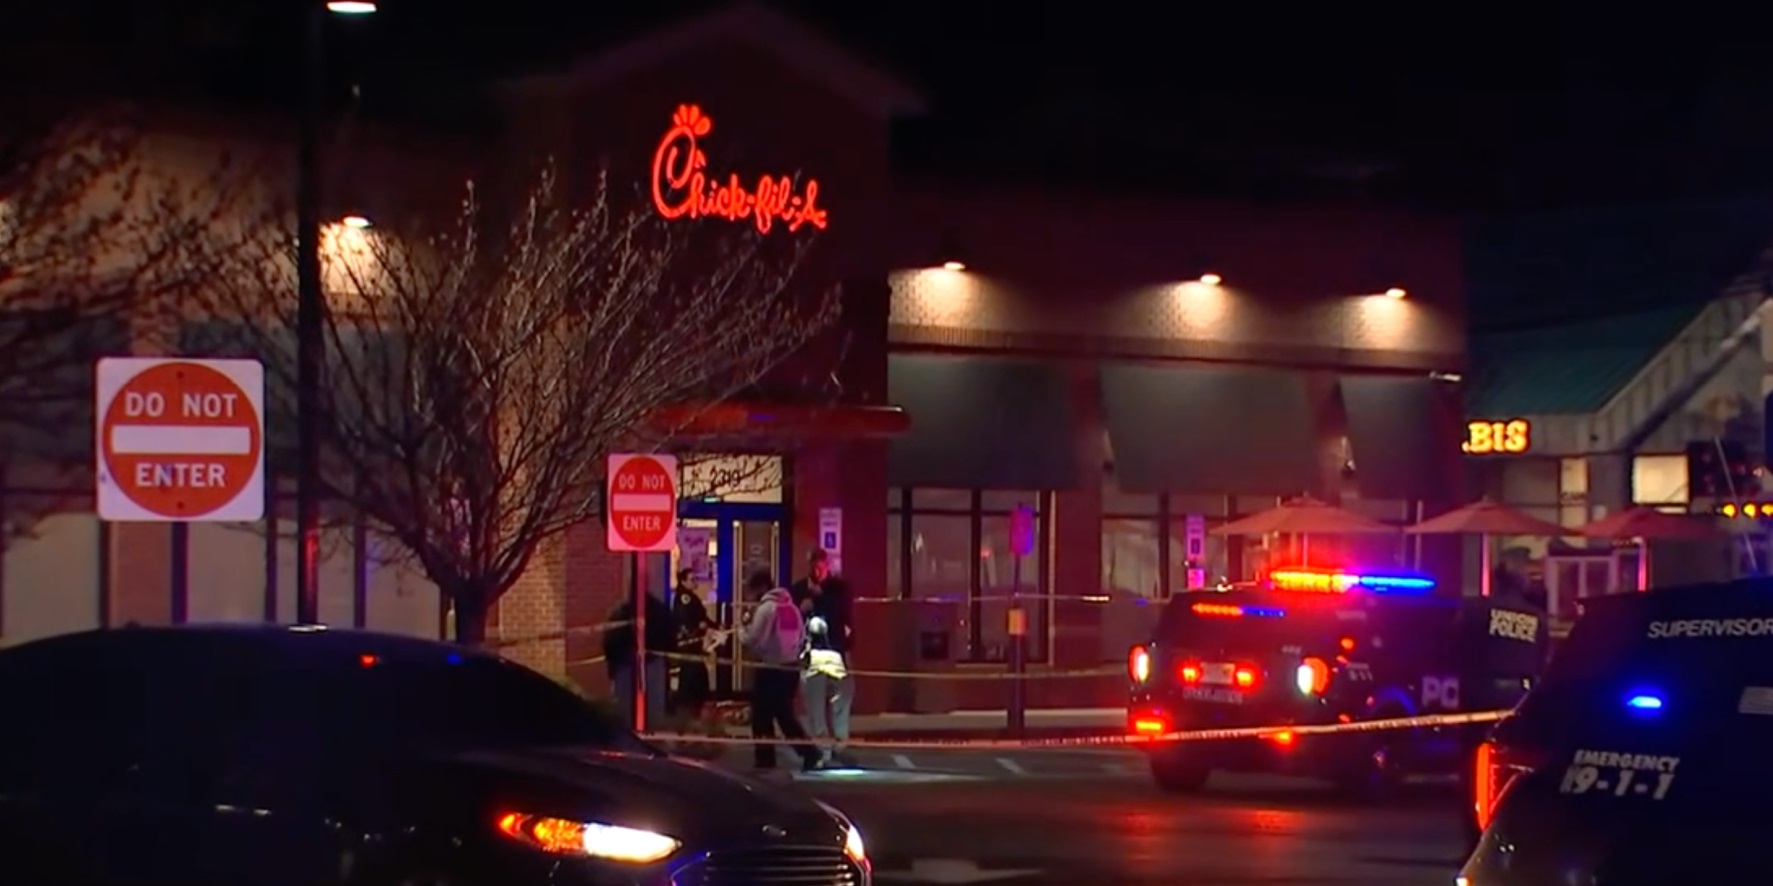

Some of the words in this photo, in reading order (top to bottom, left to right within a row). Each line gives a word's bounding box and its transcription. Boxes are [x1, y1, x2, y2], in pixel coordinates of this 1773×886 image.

[653, 104, 827, 233] Chick-fil-A
[125, 392, 165, 417] DO
[182, 393, 237, 418] NOT
[1462, 420, 1528, 452] BIS
[135, 463, 226, 488] ENTER
[618, 474, 636, 490] DO
[642, 474, 666, 490] NOT
[623, 515, 661, 531] ENTER
[1489, 618, 1537, 642] POLICE
[1647, 618, 1773, 638] SUPERVISOR
[1573, 749, 1680, 771] EMERGENCY
